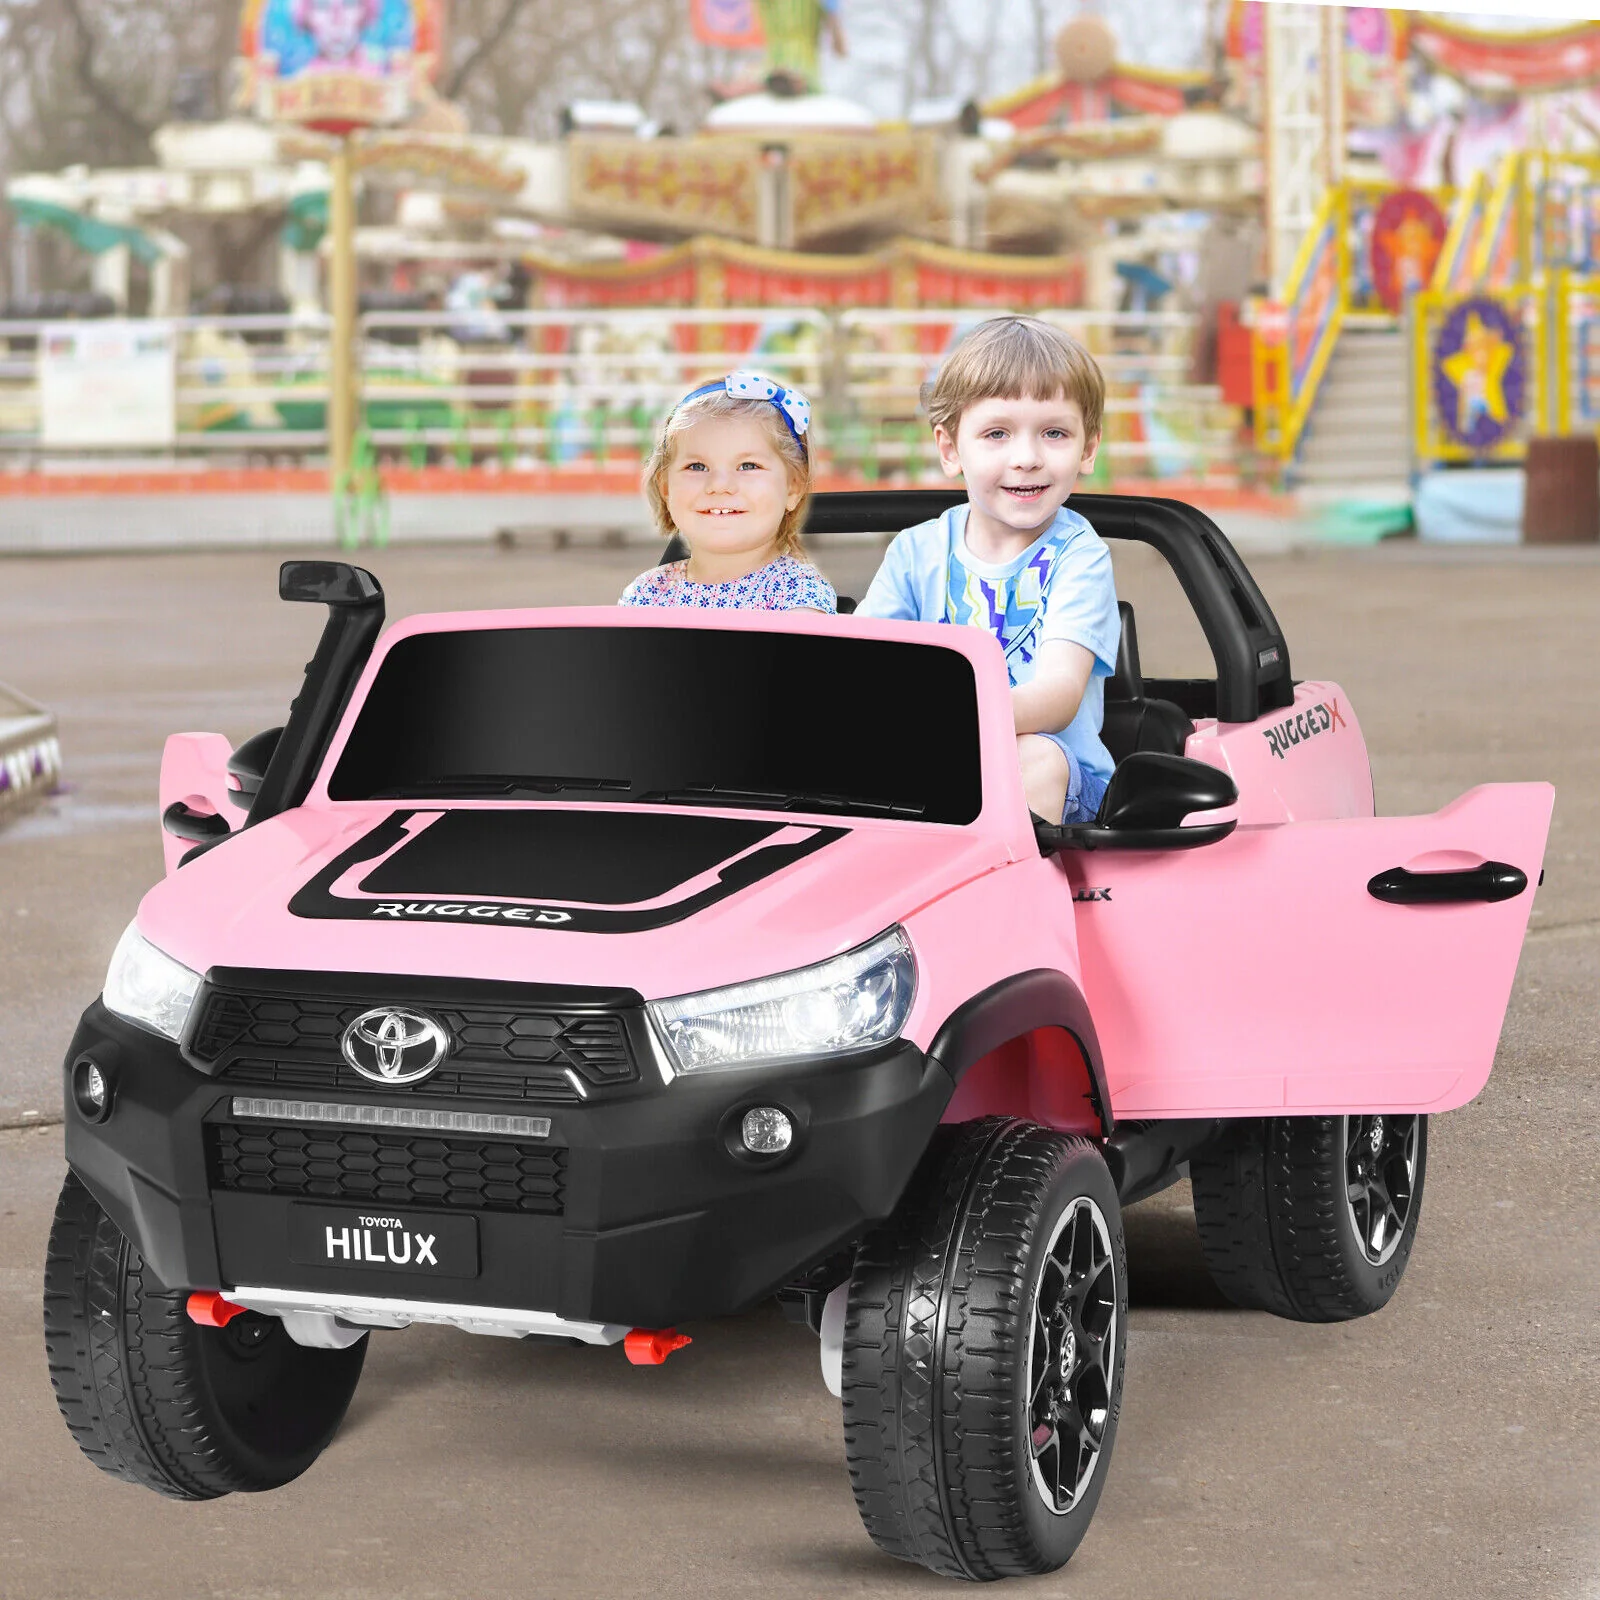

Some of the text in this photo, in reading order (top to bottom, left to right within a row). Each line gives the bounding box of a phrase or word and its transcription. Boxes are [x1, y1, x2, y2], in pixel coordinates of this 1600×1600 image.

[372, 903, 573, 924] RUGGED
[358, 1216, 403, 1229] TOYOTA
[326, 1226, 438, 1266] HILUX
